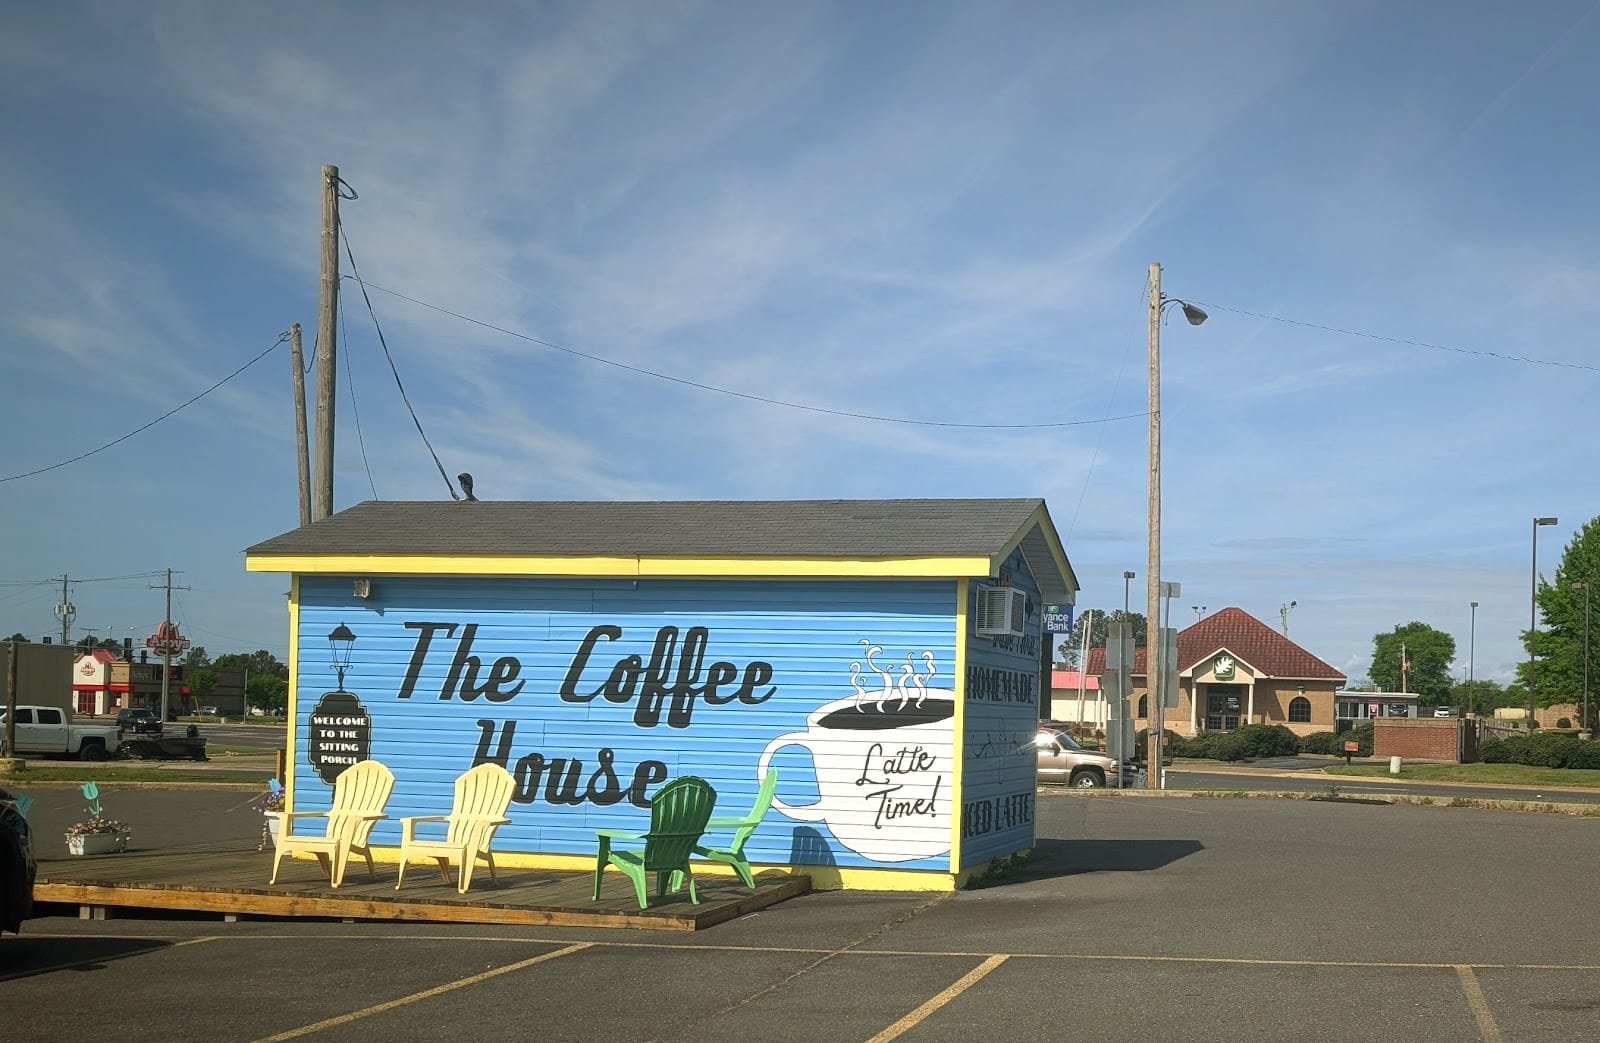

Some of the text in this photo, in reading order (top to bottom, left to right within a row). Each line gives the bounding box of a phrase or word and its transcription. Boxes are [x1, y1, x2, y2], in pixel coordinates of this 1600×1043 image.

[1047, 621, 1069, 632] Bank
[397, 621, 777, 729] The Coffee
[966, 666, 1034, 704] HOMEMADE
[313, 716, 367, 726] WELCOME
[319, 729, 359, 739] TO THE
[319, 742, 359, 752] SITTING
[320, 755, 358, 764] PORCH
[471, 719, 668, 808] House
[855, 743, 937, 786] Latte
[866, 775, 942, 829] Time!
[963, 793, 1031, 839] ICED LATTE
